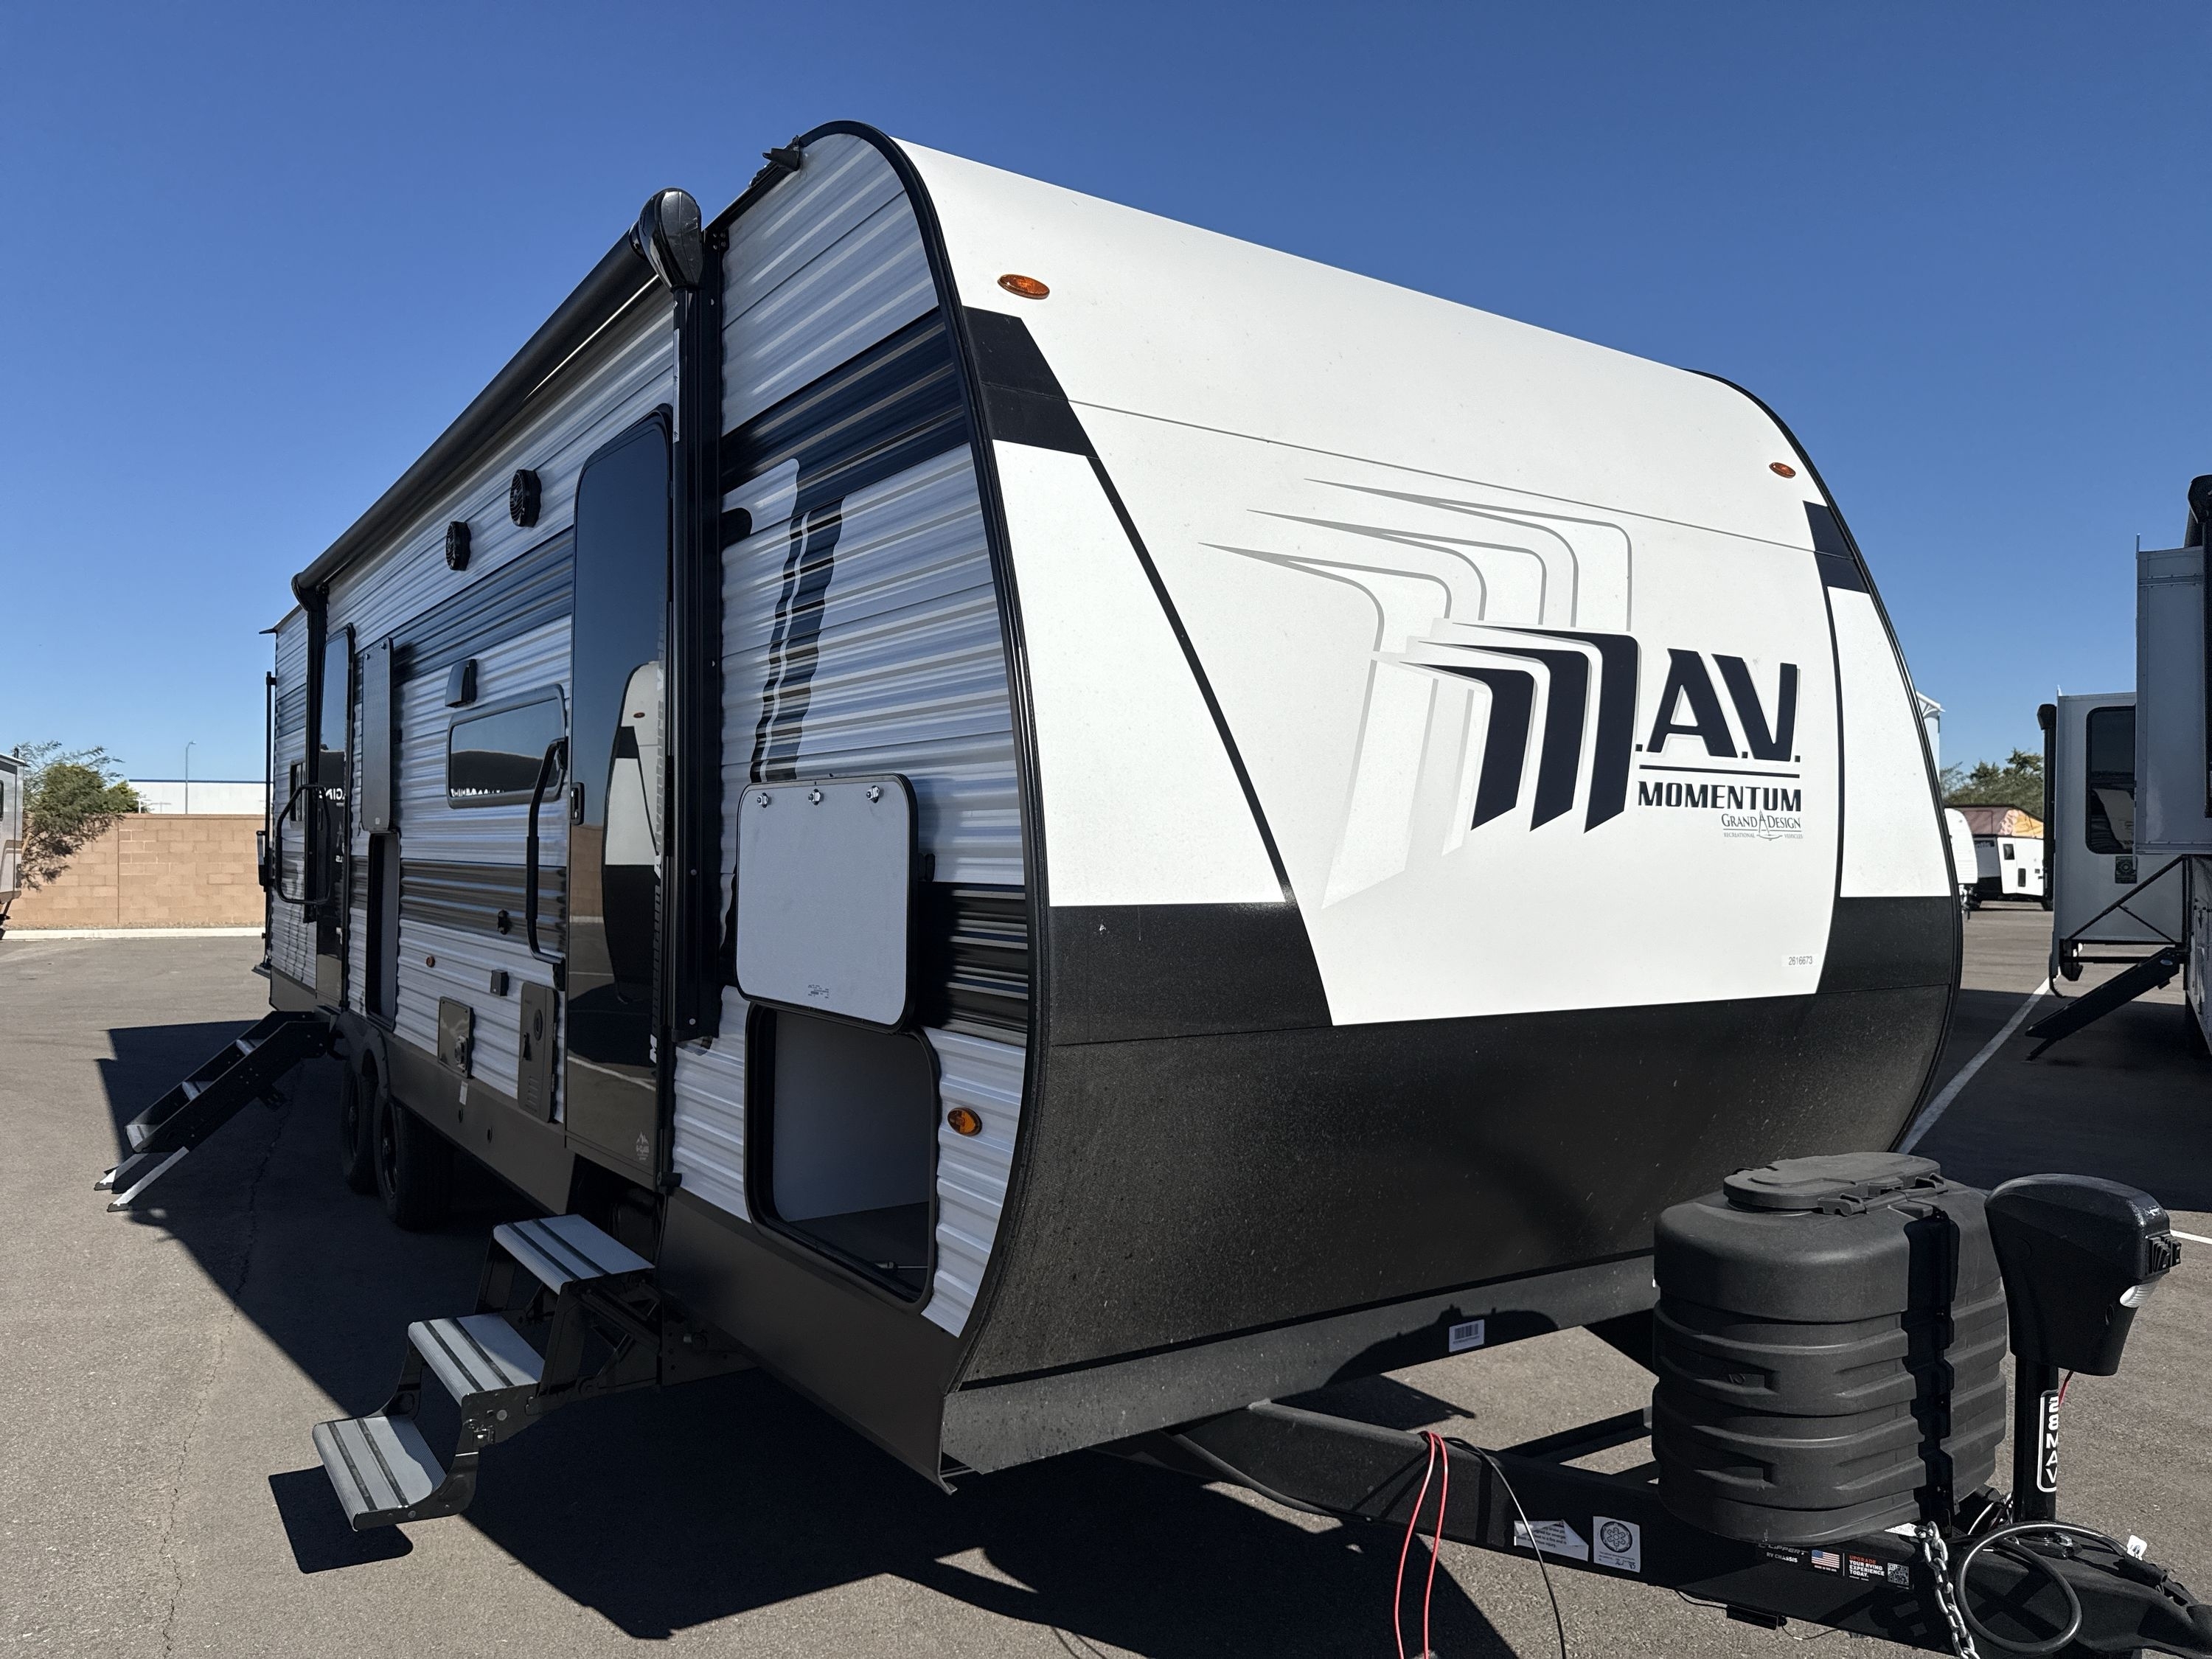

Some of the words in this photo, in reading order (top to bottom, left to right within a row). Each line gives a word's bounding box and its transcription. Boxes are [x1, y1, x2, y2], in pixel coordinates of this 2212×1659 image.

[1638, 780, 1801, 812] MOMENTUM
[1721, 813, 1758, 827] GRAND
[1775, 1554, 1798, 1563] CHASSIS
[1849, 1555, 1877, 1564] UPGRADE
[1849, 1565, 1885, 1576] EXPERIENCE
[1849, 1569, 1869, 1578] TODAY.
